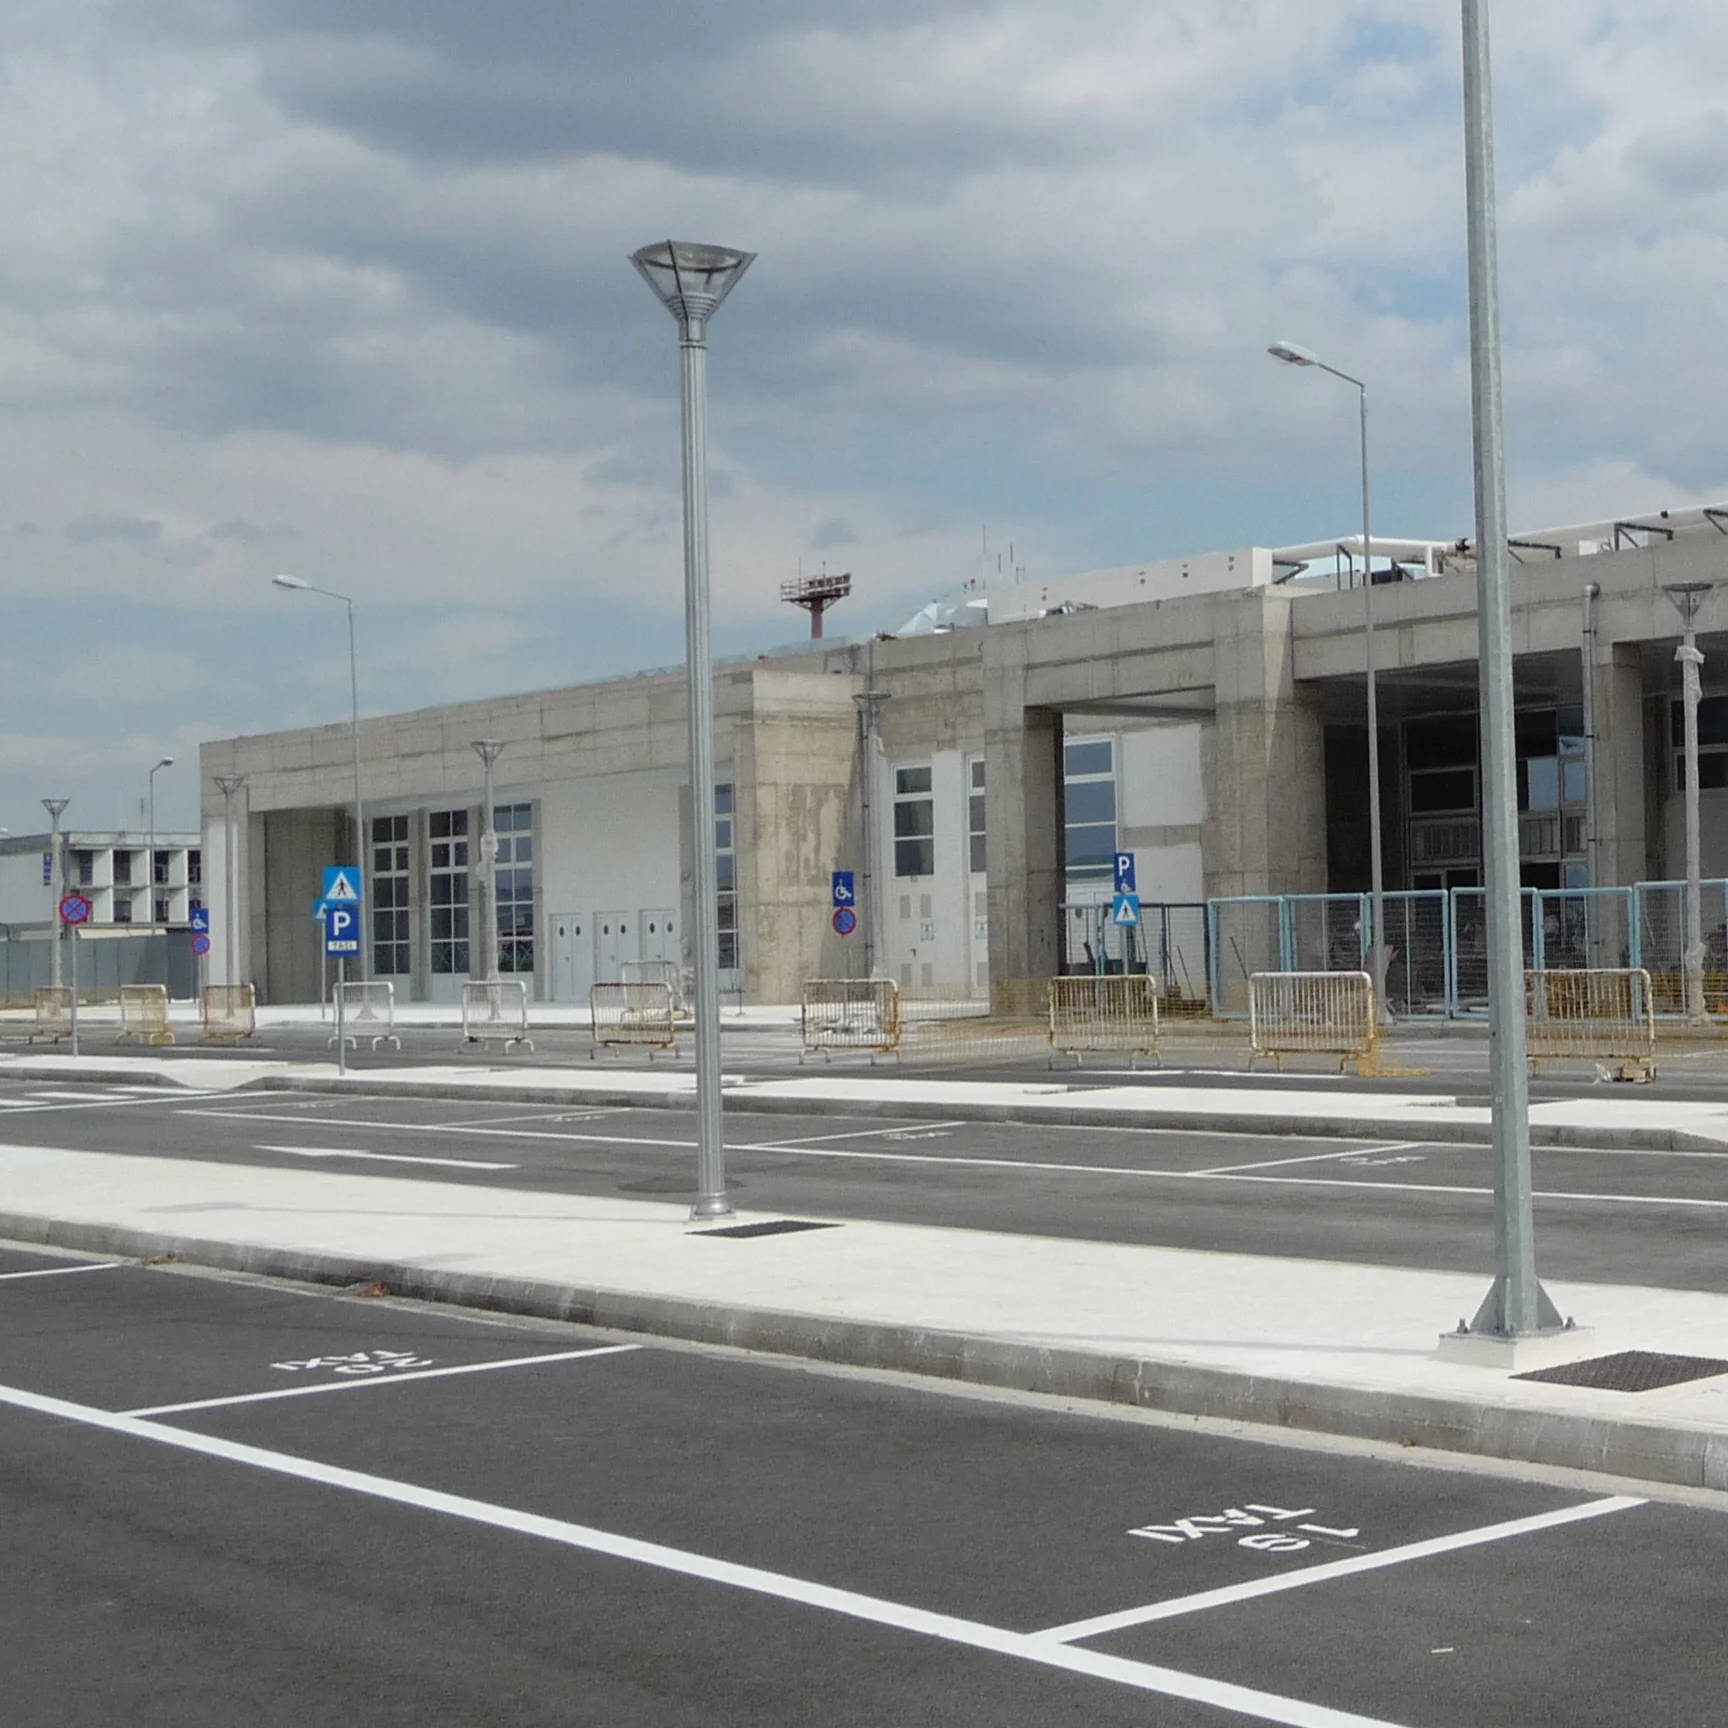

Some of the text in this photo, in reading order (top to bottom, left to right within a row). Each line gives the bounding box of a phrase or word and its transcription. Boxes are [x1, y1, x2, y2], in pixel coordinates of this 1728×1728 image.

[1118, 856, 1130, 876] P
[333, 911, 351, 936] P
[269, 1350, 415, 1371] TAXI
[1125, 1504, 1316, 1543] TAXI
